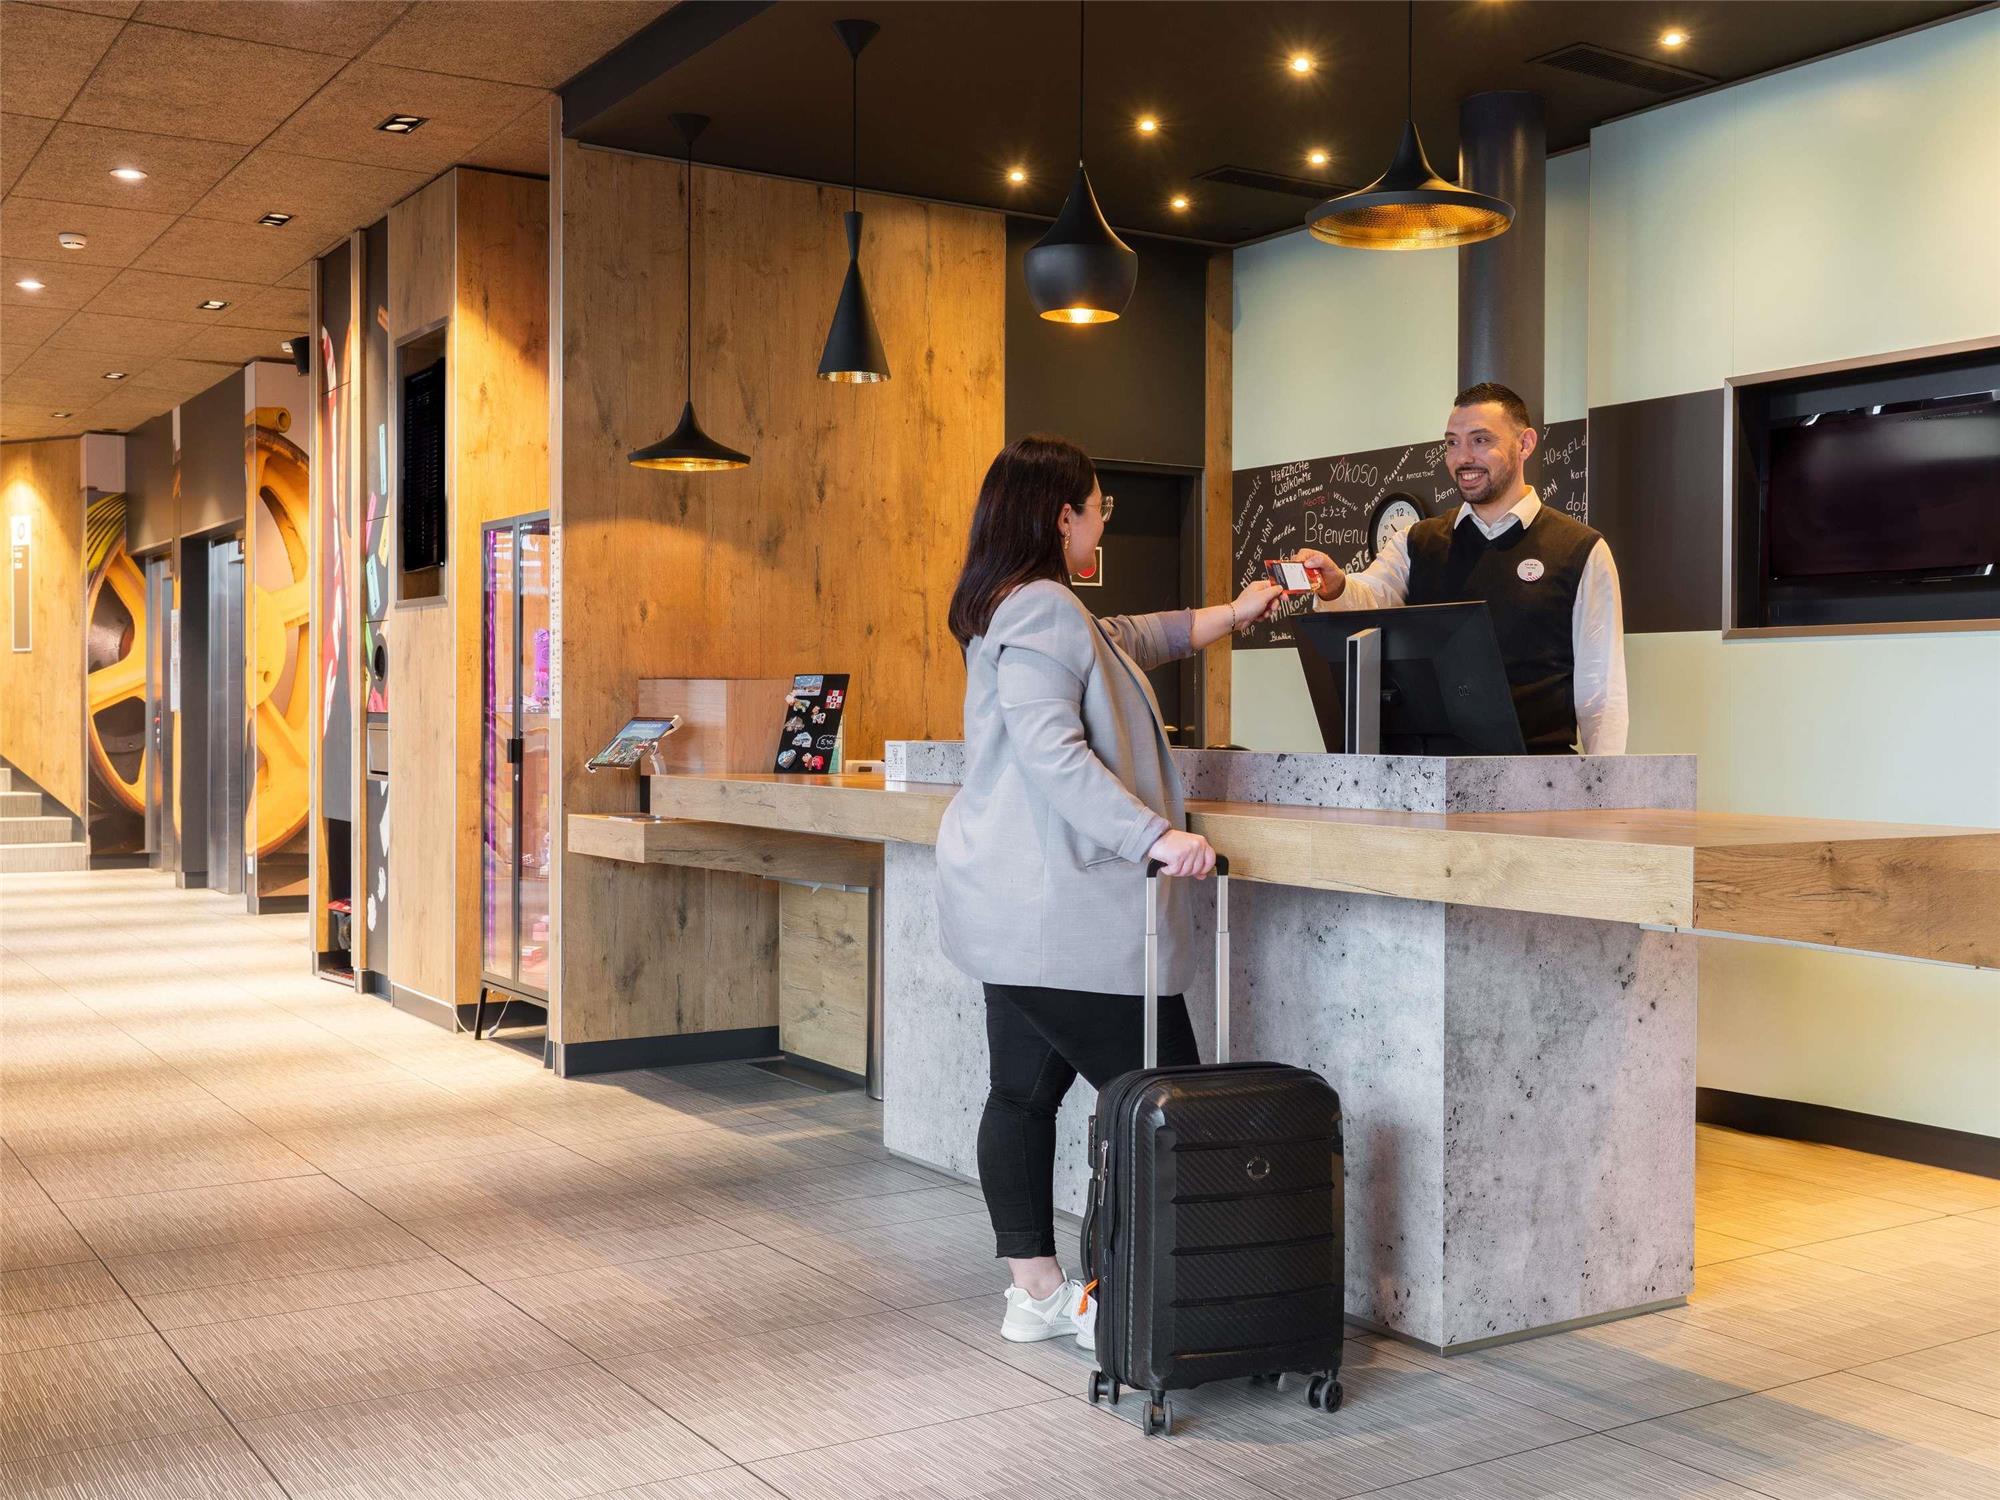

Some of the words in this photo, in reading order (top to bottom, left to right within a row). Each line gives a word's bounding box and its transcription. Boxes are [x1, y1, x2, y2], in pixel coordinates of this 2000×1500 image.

[1320, 506, 1347, 519] ようこそ
[1395, 507, 1405, 518] 12
